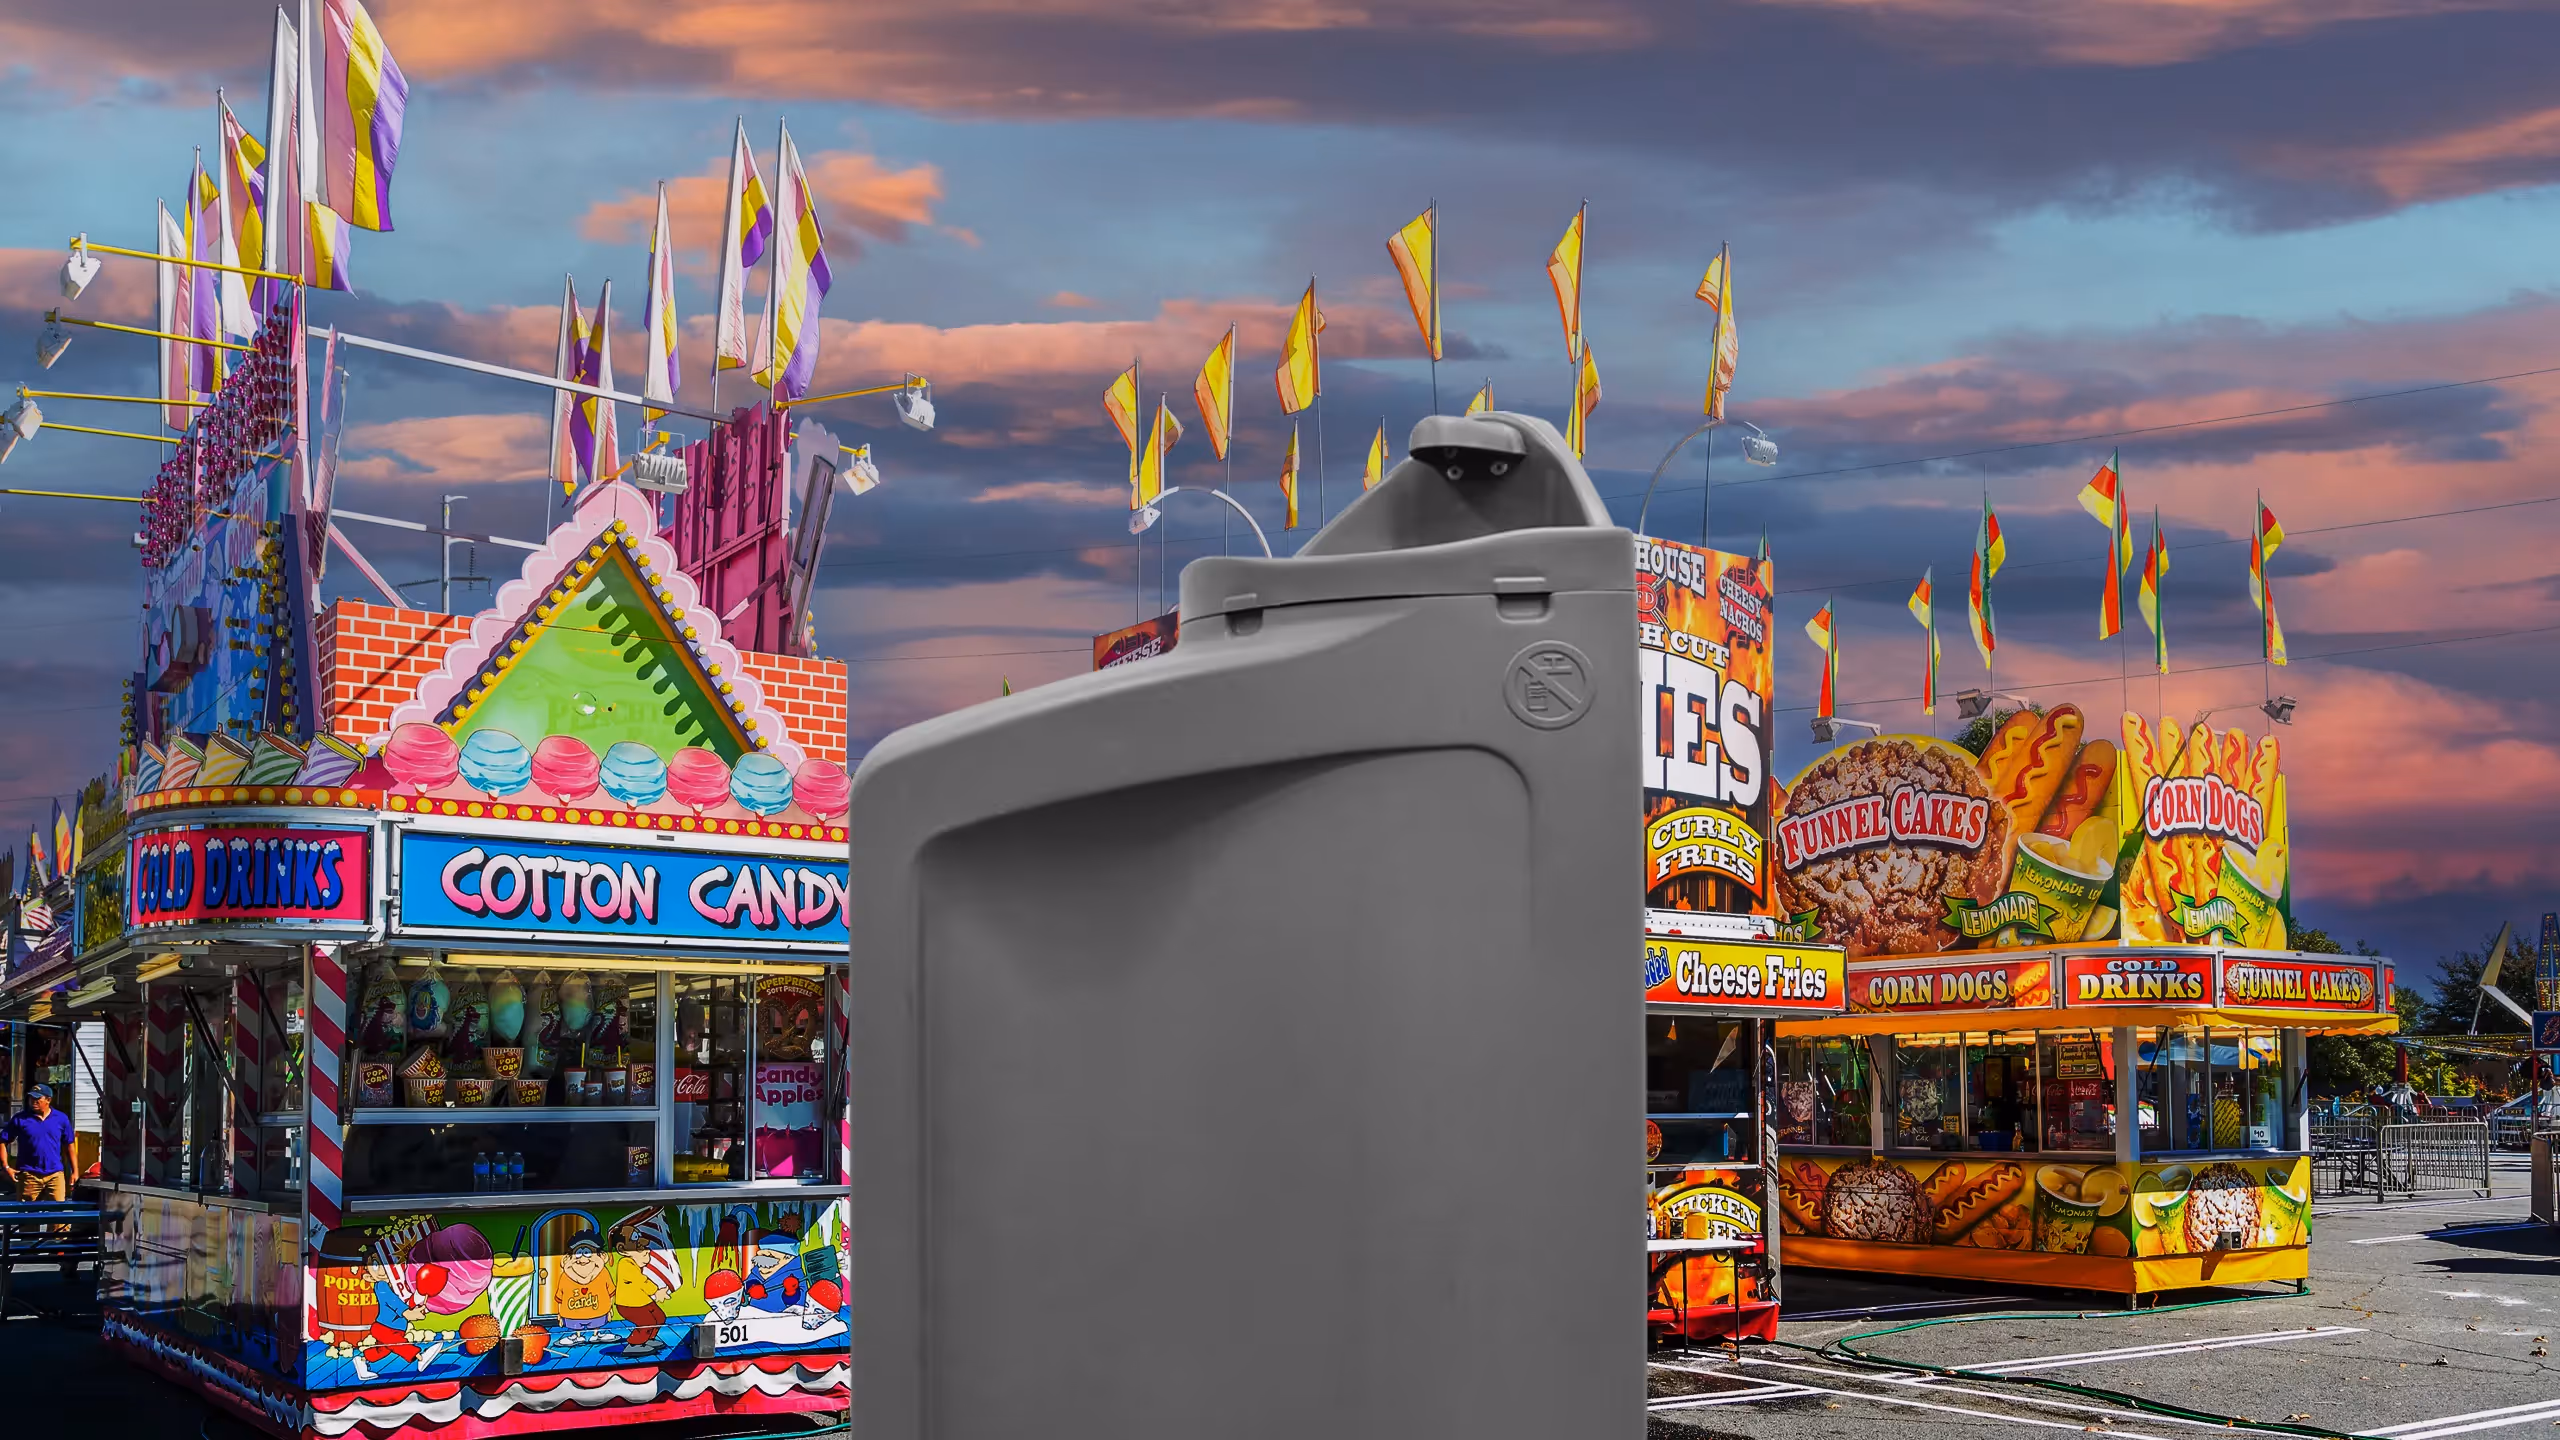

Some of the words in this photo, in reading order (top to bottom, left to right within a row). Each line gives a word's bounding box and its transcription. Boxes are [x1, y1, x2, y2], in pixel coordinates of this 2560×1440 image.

[1720, 574, 1762, 619] CHEESY
[1720, 598, 1764, 643] NACHOS
[1104, 636, 1162, 669] EESE
[1670, 631, 1730, 668] CUT
[1781, 800, 1887, 865] FUNNEL
[1894, 791, 1985, 844] CAKES
[2149, 784, 2203, 831] CORN
[2207, 780, 2260, 846] DOGS
[1652, 815, 1761, 859] CURLY
[137, 840, 194, 915] COLD
[204, 837, 344, 909] DRINKS
[1656, 844, 1755, 885] FRIES
[2025, 864, 2086, 898] LEMONADE
[441, 846, 659, 924] COTTON
[1961, 895, 2040, 936] LEMONADE
[2184, 900, 2236, 934] LEMONADE
[1676, 950, 1761, 996] Cheese
[1765, 954, 1827, 998] Fries
[2106, 960, 2179, 973] COLD
[766, 986, 782, 996] SOFT
[783, 986, 813, 997] PRETZELS
[1869, 974, 1934, 1007] CORN
[1940, 969, 2008, 1003] DOGS
[2077, 972, 2204, 1000] DRINKS
[2237, 966, 2307, 1001] FUNNEL
[2309, 970, 2362, 1002] CAKES
[365, 1074, 388, 1085] CORN
[366, 1069, 384, 1078] POP
[498, 1063, 518, 1072] CORN
[637, 1070, 652, 1079] POP
[756, 1066, 823, 1087] Candy
[461, 1089, 479, 1097] POP
[522, 1089, 539, 1097] POP
[1915, 1134, 1930, 1142] CAK
[634, 1152, 649, 1161] POP
[568, 1293, 599, 1310] Candy
[720, 1325, 749, 1344] 501
